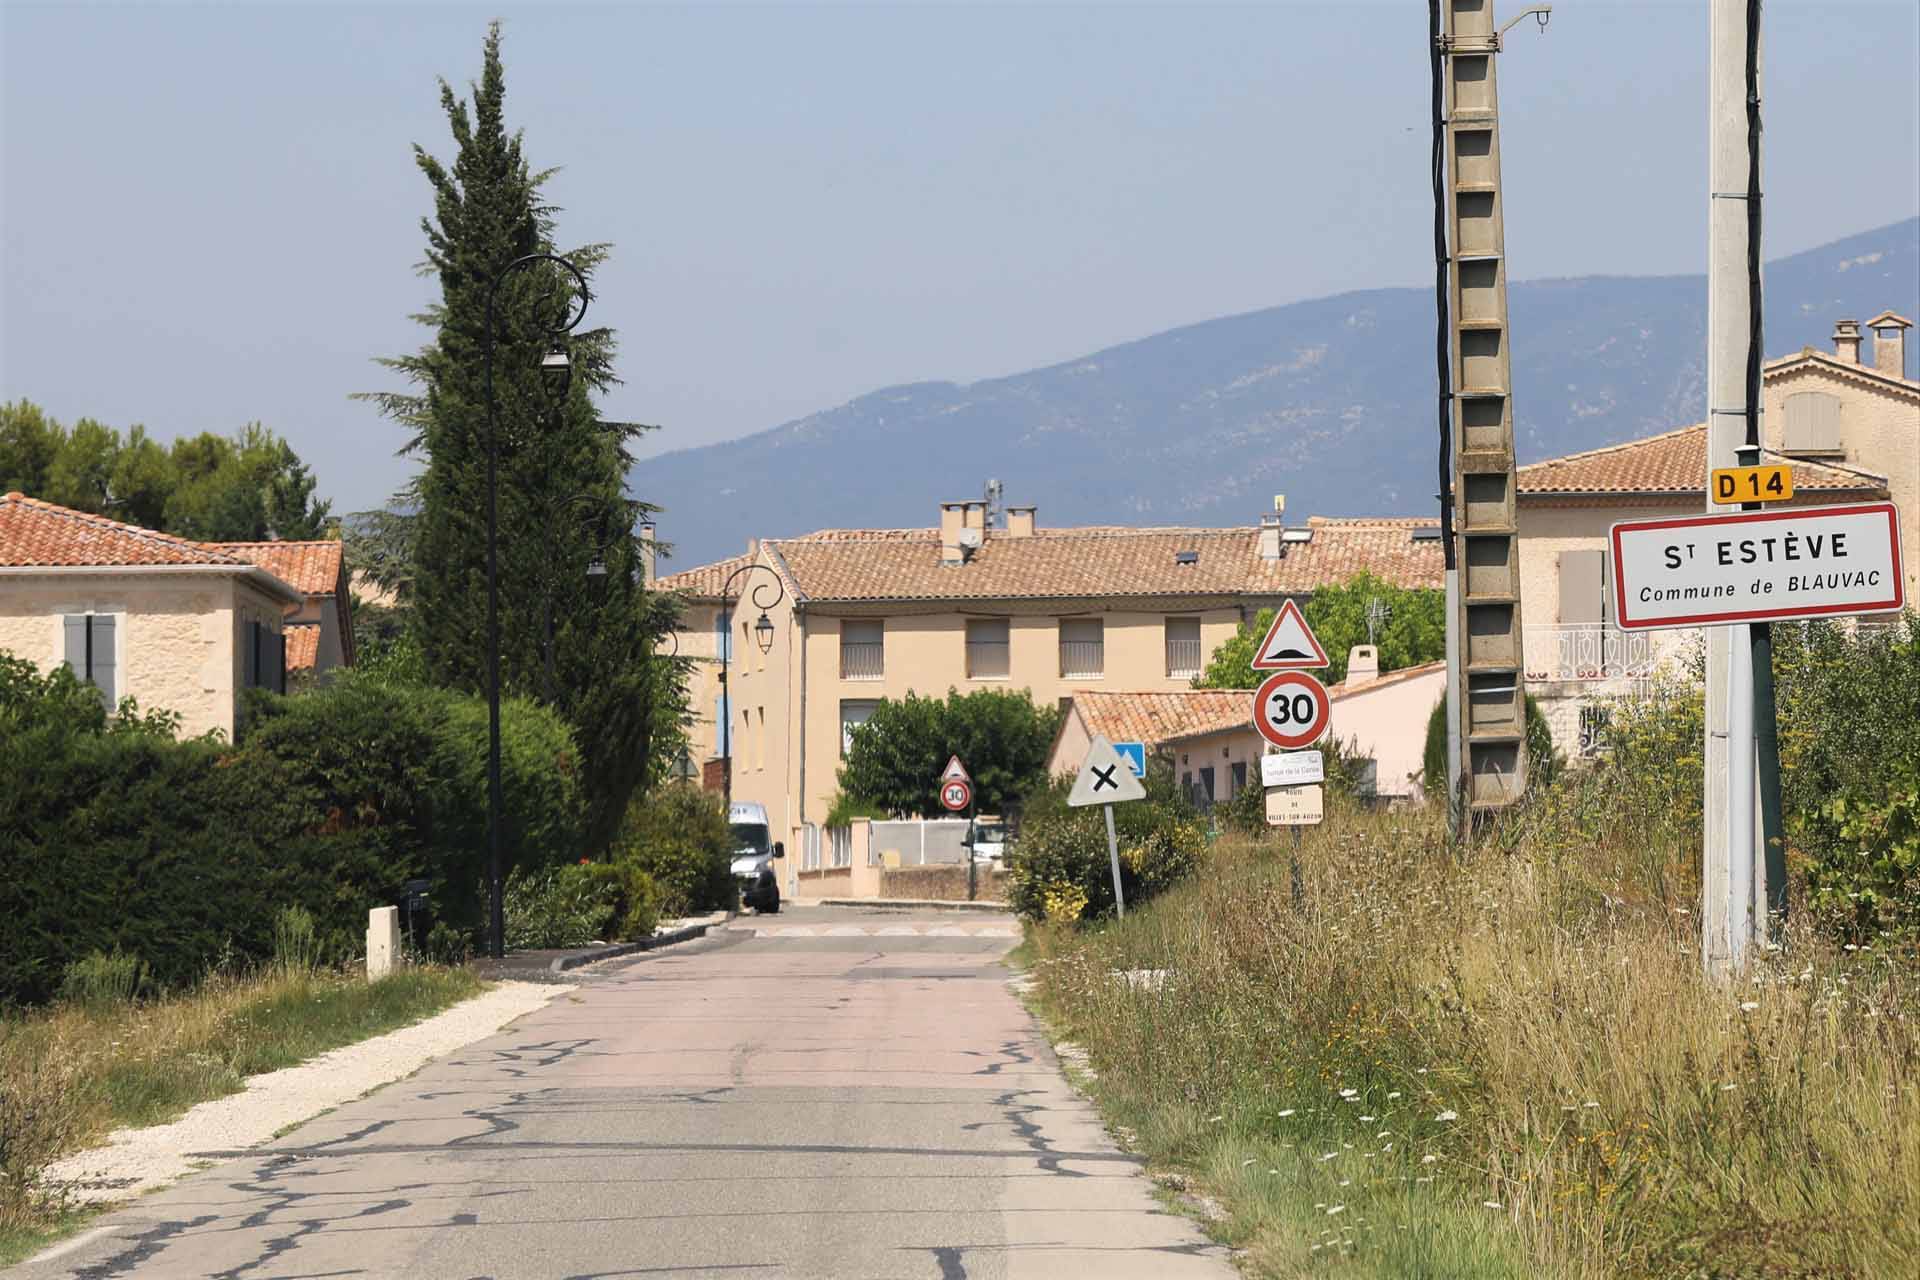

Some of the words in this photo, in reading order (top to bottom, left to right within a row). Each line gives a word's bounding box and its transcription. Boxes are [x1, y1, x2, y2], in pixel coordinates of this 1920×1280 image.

[1719, 474, 1736, 498] D
[1748, 471, 1784, 497] 14
[1717, 531, 1848, 566] ESTÈVE
[1640, 584, 1736, 602] Commune
[1750, 579, 1773, 595] de
[1788, 570, 1880, 592] BLAUVAC
[1271, 694, 1314, 725] 30
[948, 789, 964, 802] 30
